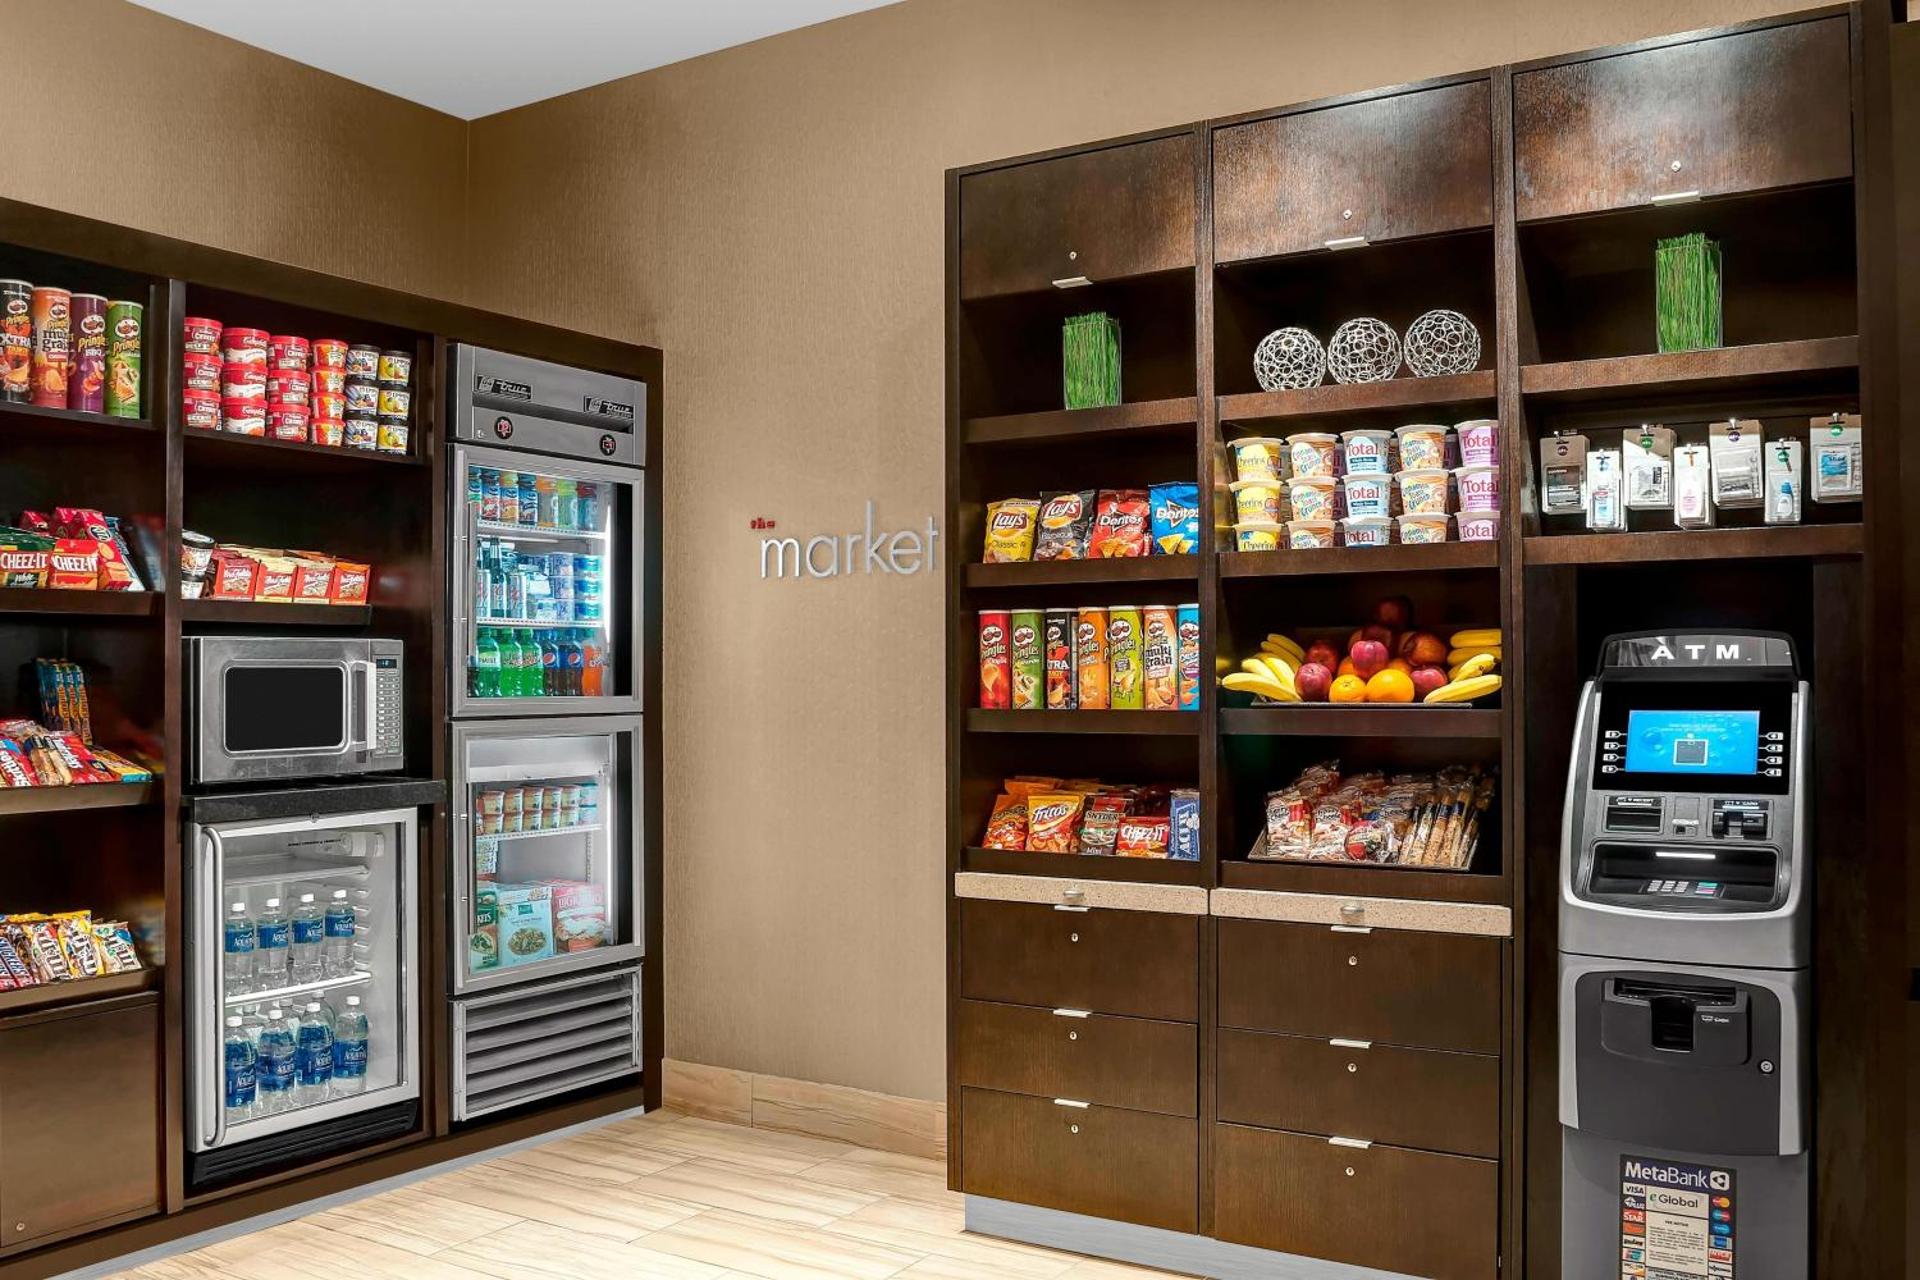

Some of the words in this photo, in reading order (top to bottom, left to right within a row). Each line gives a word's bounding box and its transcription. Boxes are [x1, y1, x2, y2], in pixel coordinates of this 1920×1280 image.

[1463, 435, 1496, 448] Total
[1346, 443, 1378, 456] Total
[1348, 486, 1381, 499] Total
[1464, 480, 1499, 494] Total
[751, 518, 776, 529] the
[1101, 514, 1144, 527] Doritos
[1344, 530, 1374, 543] Total
[1461, 523, 1495, 538] Total
[760, 499, 940, 579] market
[0, 553, 48, 569] CHEEZ-IT
[55, 556, 98, 572] CHEEZ-IT
[1651, 644, 1740, 660] ATM
[1624, 1161, 1710, 1189] MetaBank
[1626, 1185, 1644, 1195] VISA
